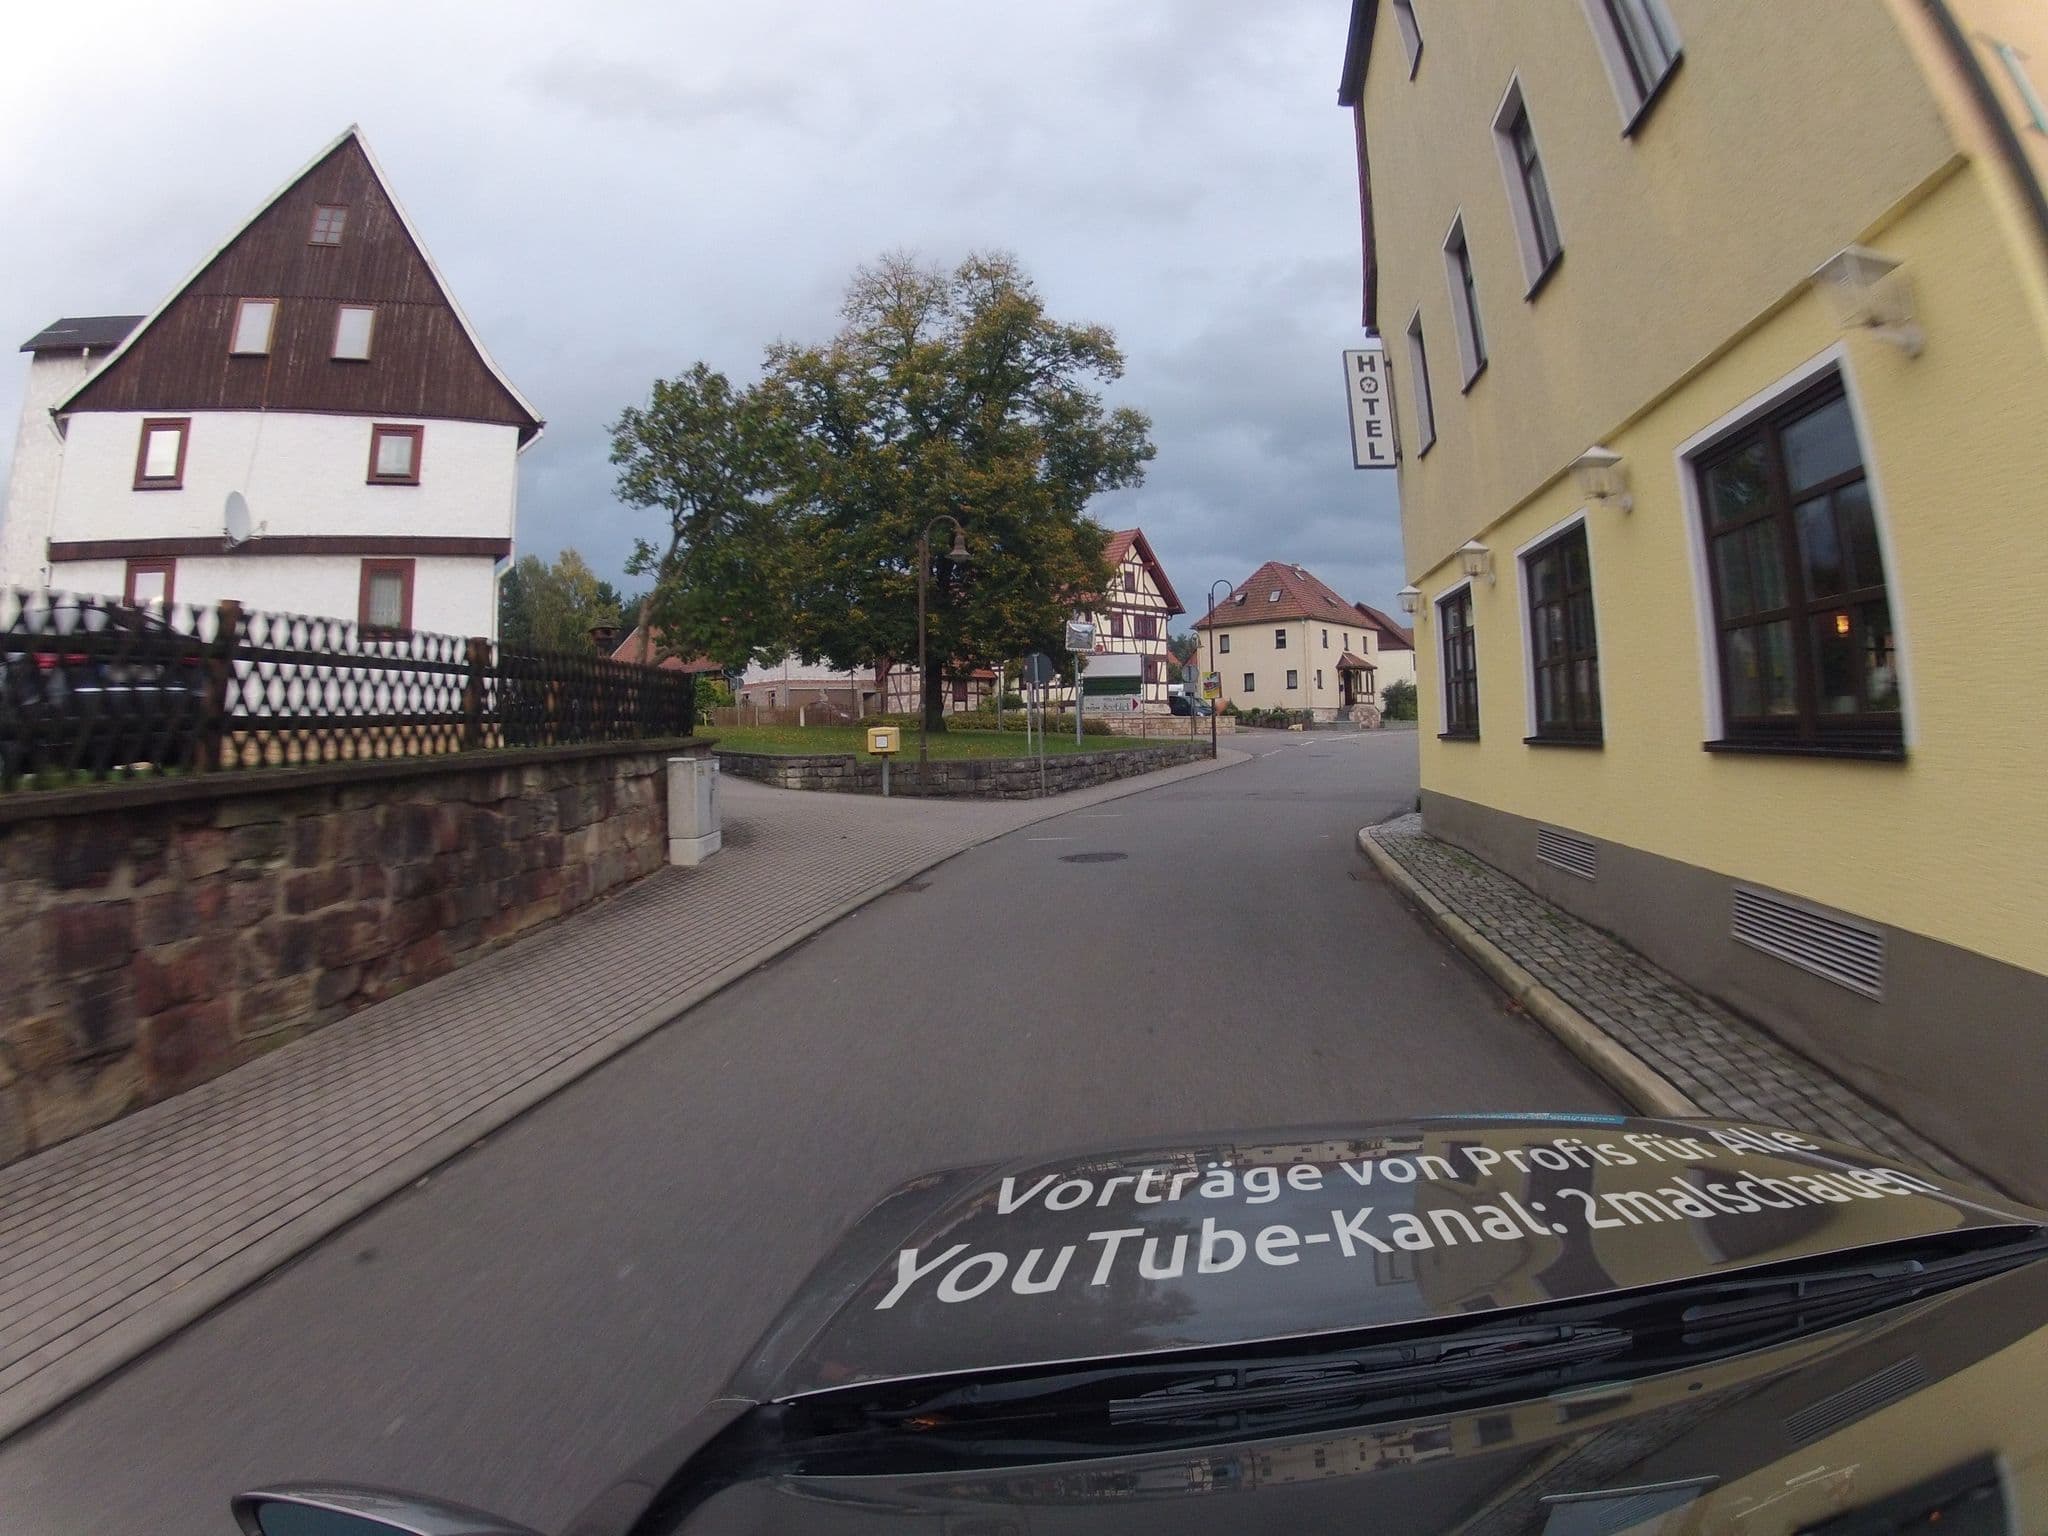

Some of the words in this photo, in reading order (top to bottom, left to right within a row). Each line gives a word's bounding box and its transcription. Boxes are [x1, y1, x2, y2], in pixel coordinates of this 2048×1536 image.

[1357, 355, 1384, 460] HOTEL
[996, 1162, 1323, 1214] Vorträge
[1340, 1153, 1459, 1186] von
[1461, 1137, 1637, 1178] Profis
[1632, 1132, 1717, 1162] für
[1709, 1127, 1819, 1156] Alle
[875, 1192, 1568, 1310] YouTube-Kanal:
[1557, 1164, 1942, 1229] 2malschauen
